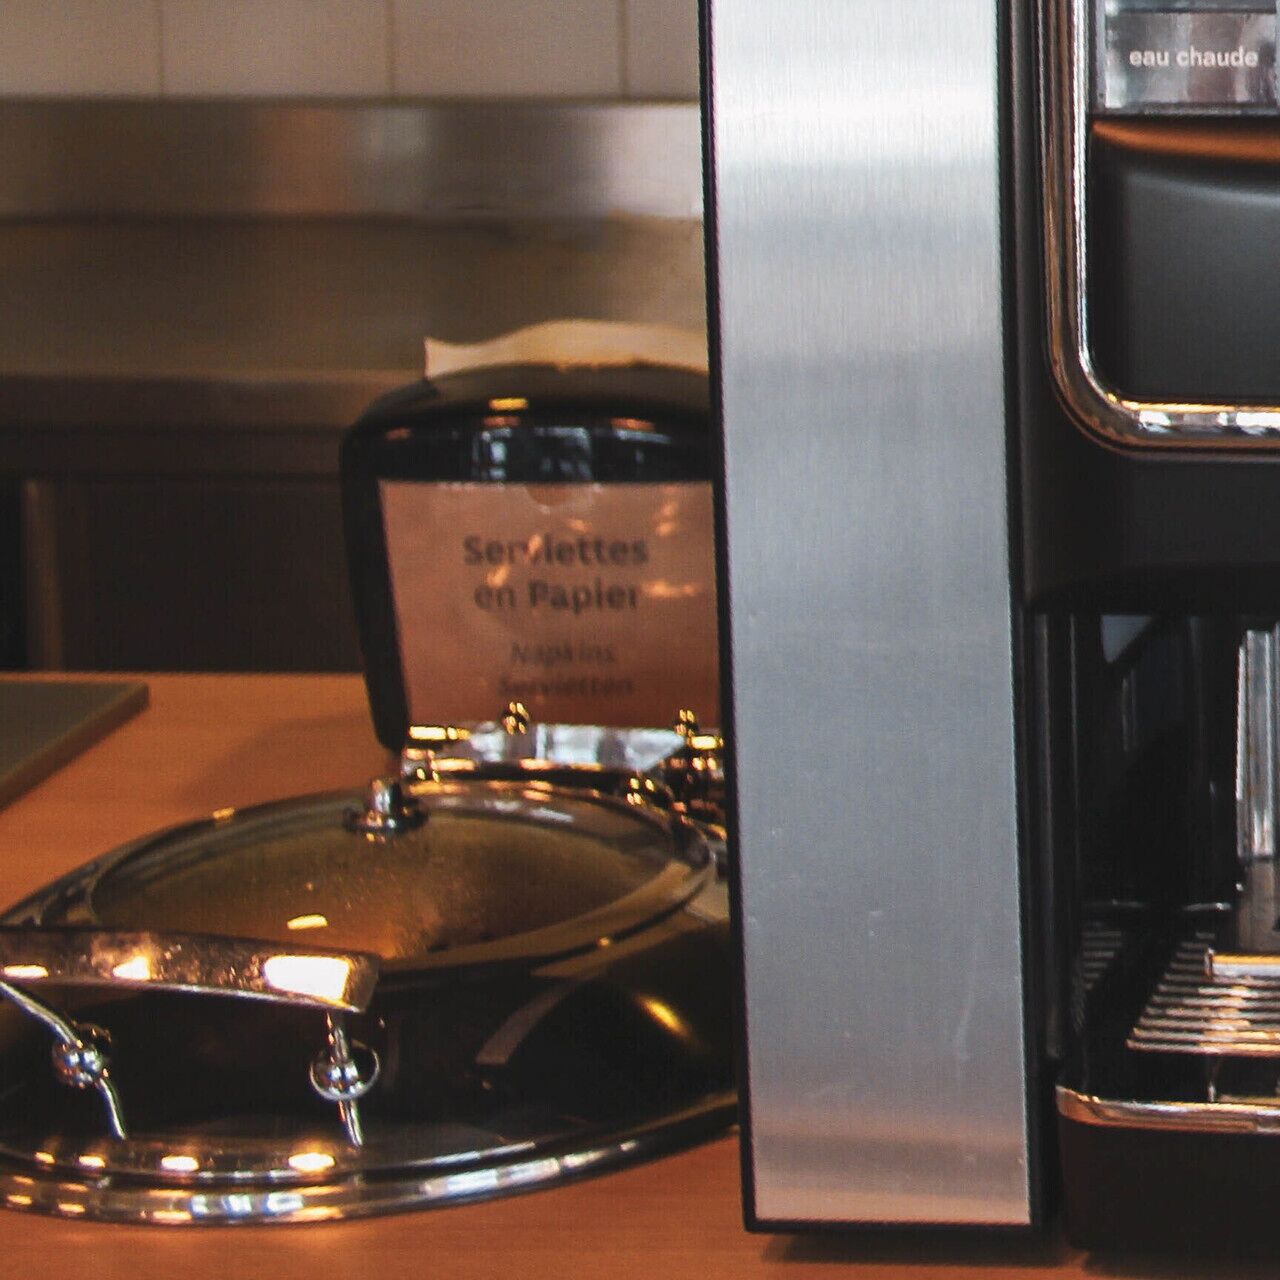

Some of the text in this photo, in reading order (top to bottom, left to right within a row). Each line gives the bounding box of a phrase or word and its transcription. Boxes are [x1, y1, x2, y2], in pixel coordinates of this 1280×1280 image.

[1129, 47, 1259, 68] eau chaude
[474, 577, 642, 615] en Papier
